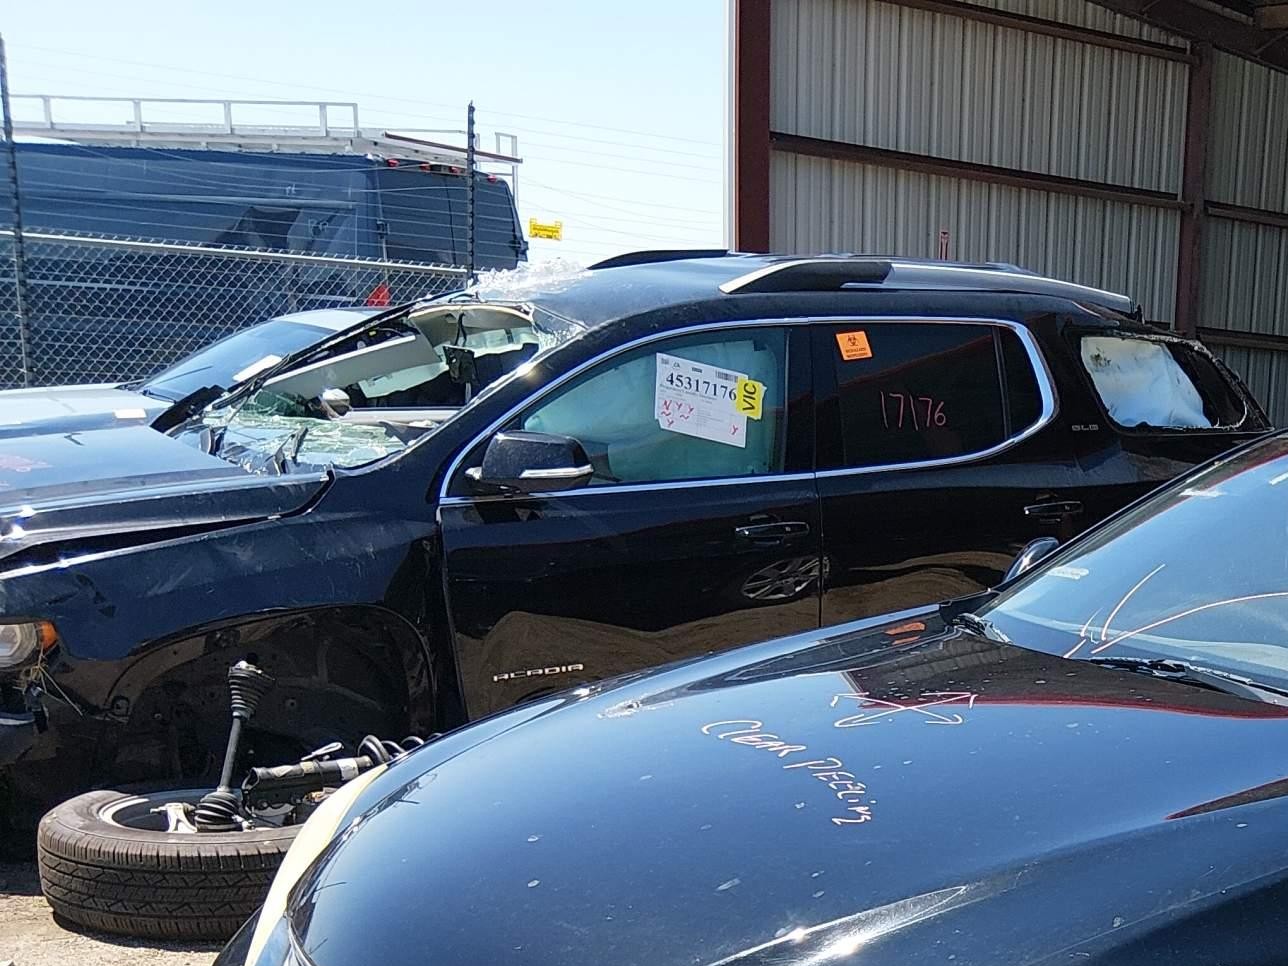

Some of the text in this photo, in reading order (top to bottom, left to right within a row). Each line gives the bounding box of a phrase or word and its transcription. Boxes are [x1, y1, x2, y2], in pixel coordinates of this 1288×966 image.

[665, 372, 737, 401] 45317176
[742, 382, 757, 411] VIC
[880, 390, 946, 431] 17176
[493, 663, 584, 682] ACADIA
